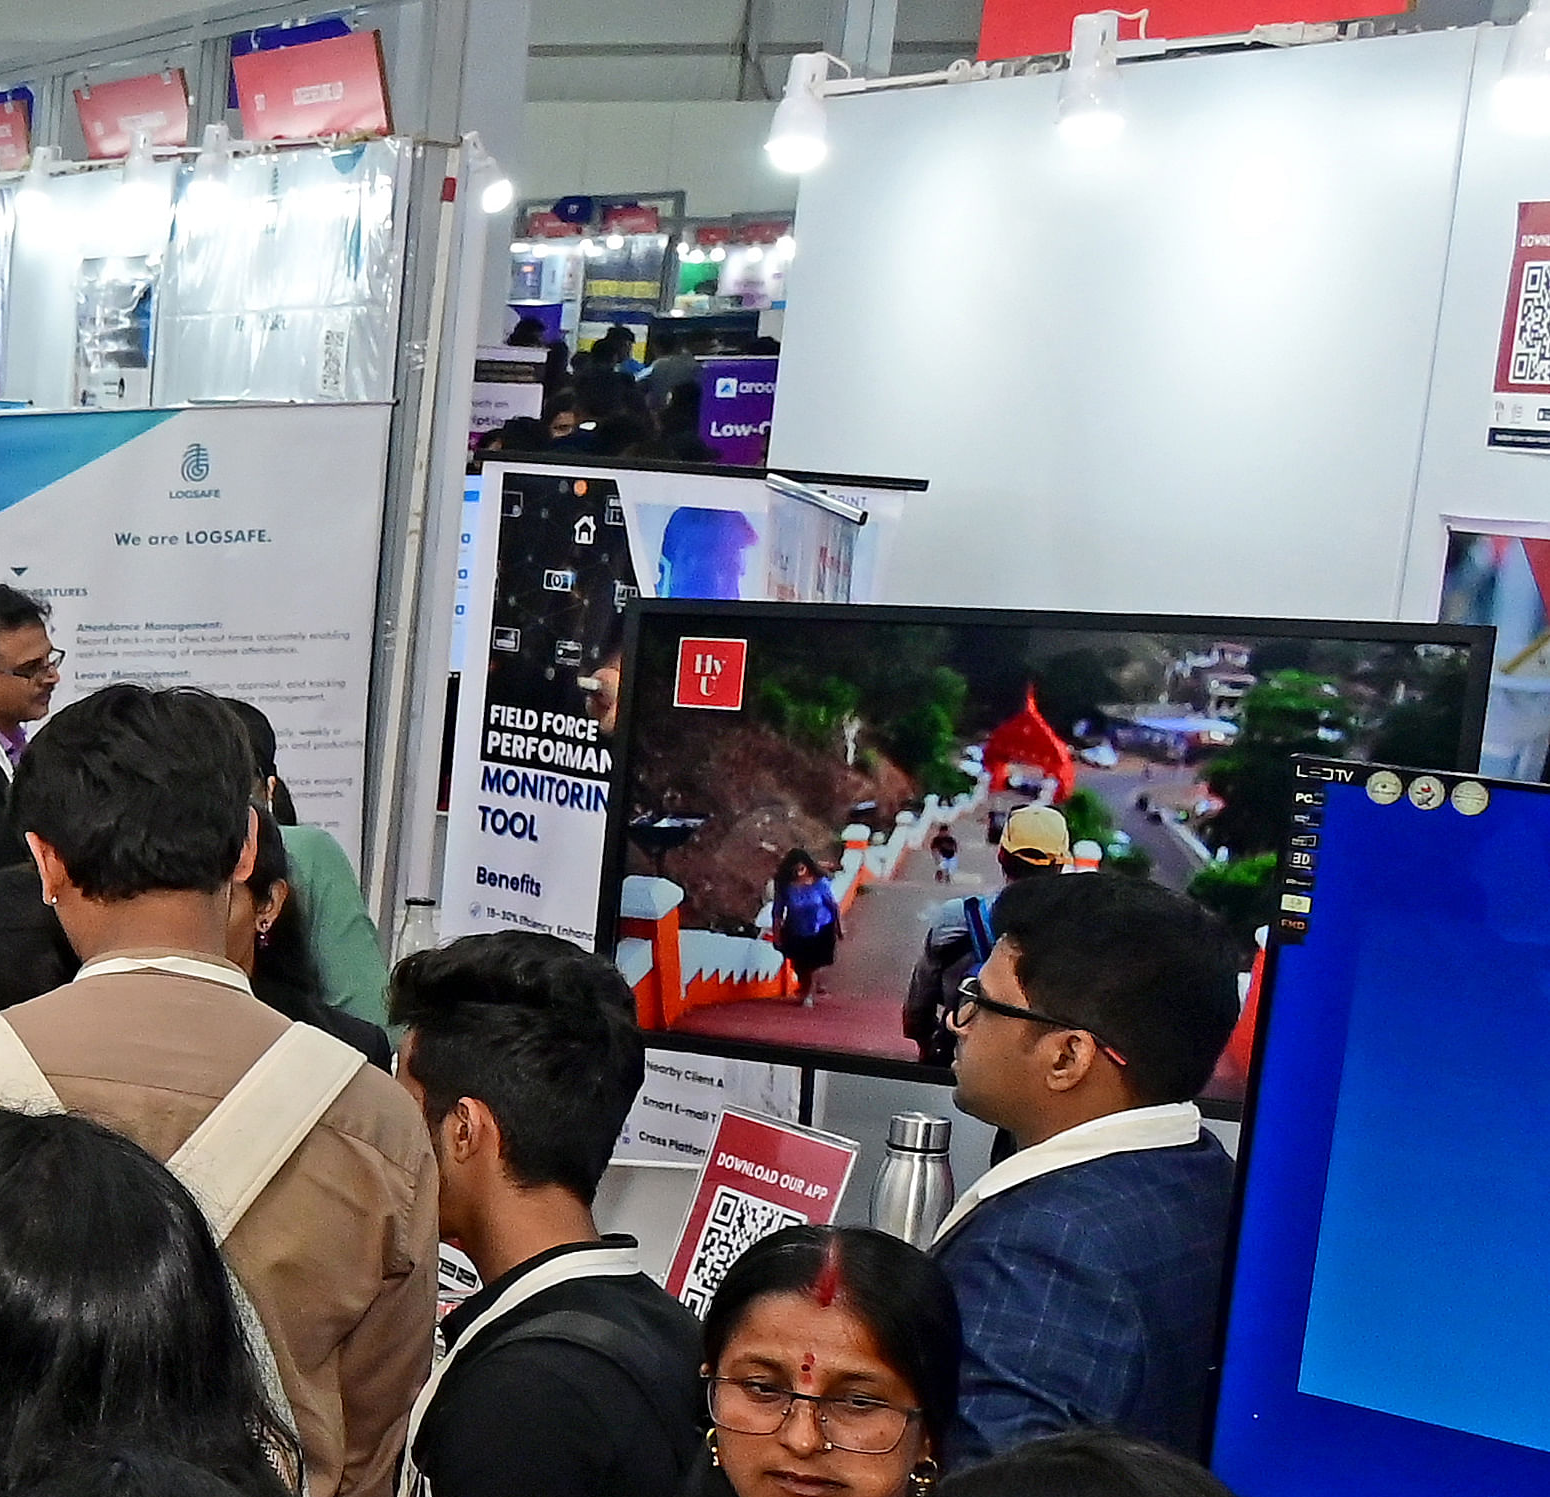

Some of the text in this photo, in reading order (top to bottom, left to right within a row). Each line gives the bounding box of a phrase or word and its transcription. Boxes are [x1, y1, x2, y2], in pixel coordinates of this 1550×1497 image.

[113, 529, 274, 547] We are LOGSAFE.
[76, 620, 223, 633] Attendance Management:
[74, 670, 107, 681] Leave
[489, 703, 599, 743] FIELD FORCE
[477, 804, 539, 843] TOOL
[476, 865, 542, 899] Benefits
[642, 1095, 674, 1114] Smart
[674, 1103, 709, 1123] E-mail
[639, 1130, 668, 1148] Cross
[716, 1151, 829, 1202] DOWNLOAD OUR APP
